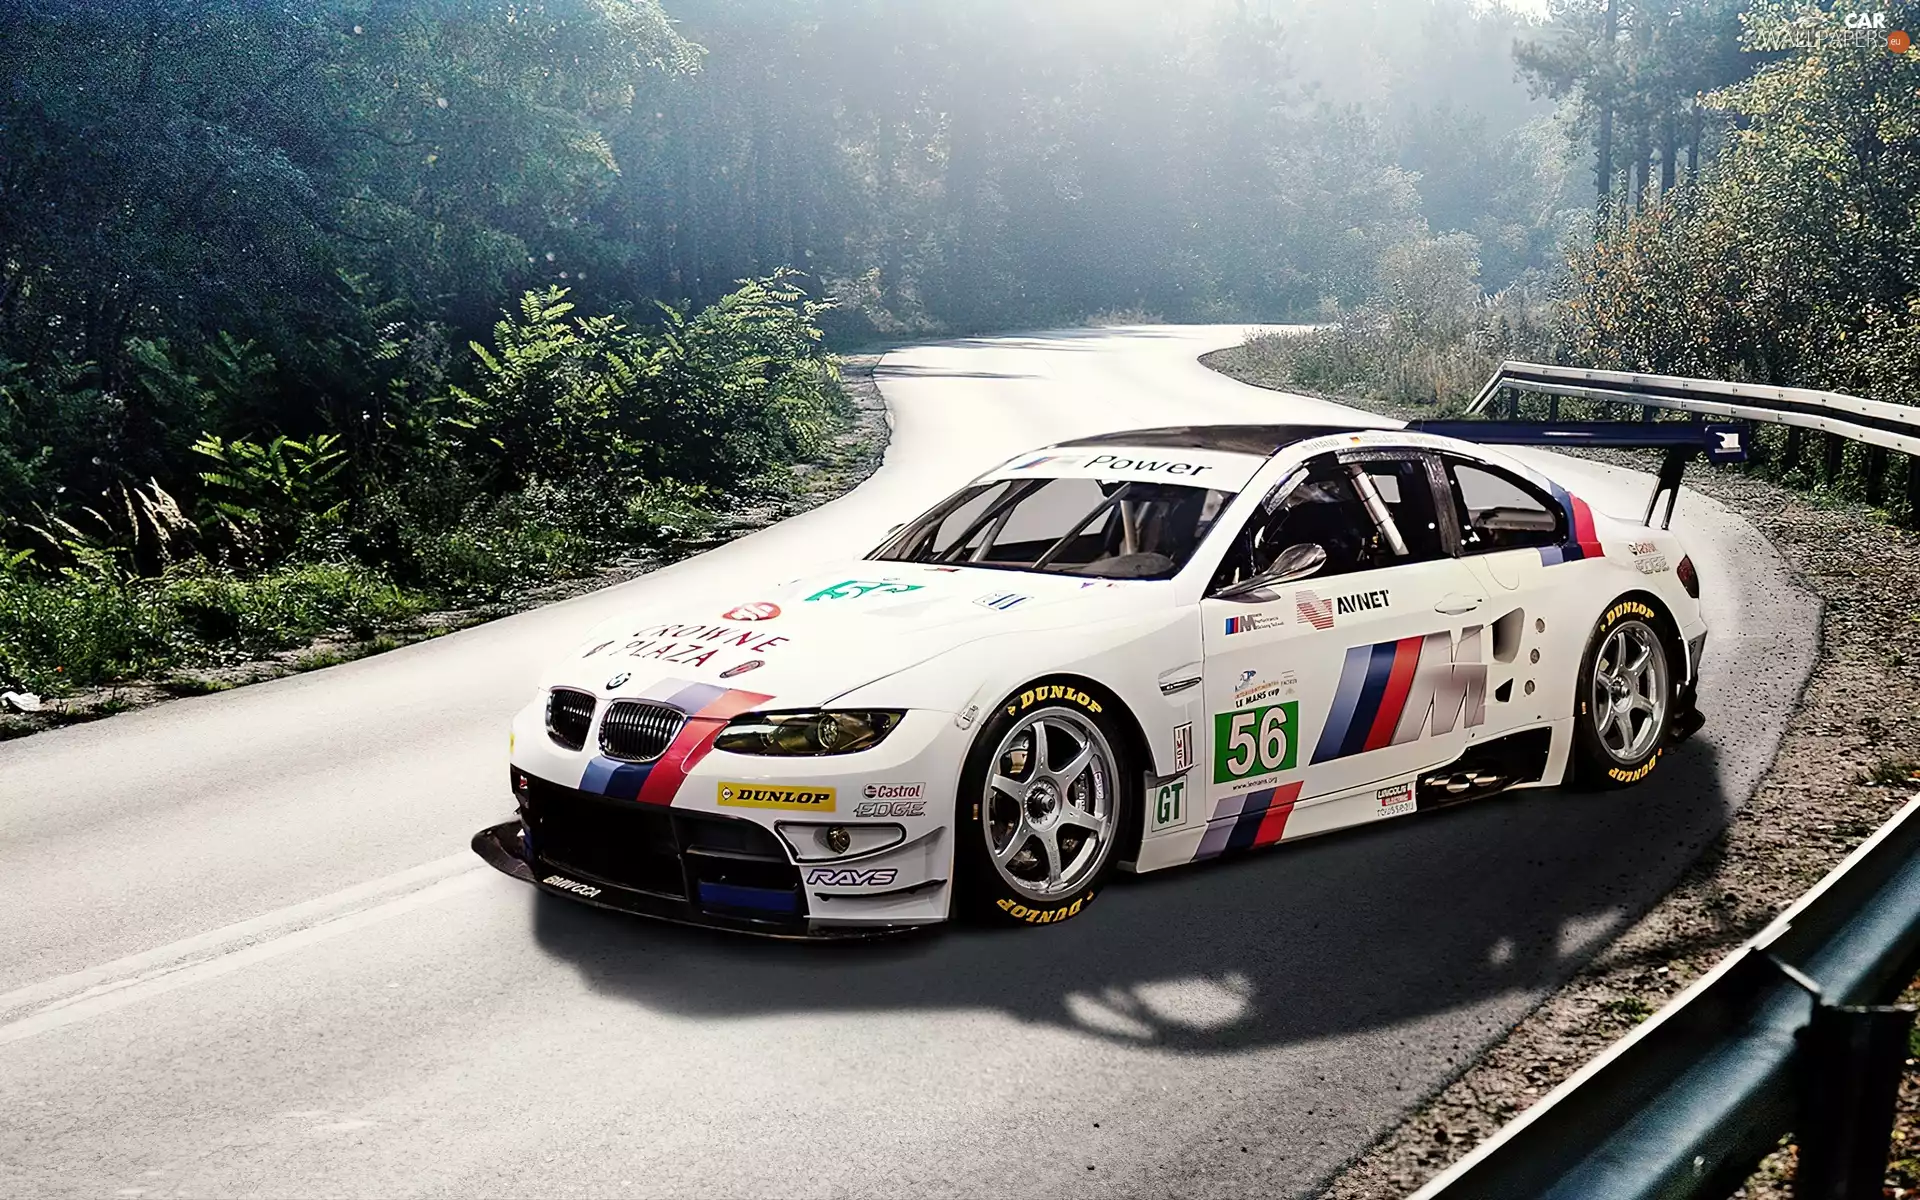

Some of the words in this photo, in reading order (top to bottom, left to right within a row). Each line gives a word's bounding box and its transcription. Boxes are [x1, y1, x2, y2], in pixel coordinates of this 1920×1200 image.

[1084, 455, 1213, 476] Power
[1337, 589, 1391, 615] AVNET
[1606, 601, 1655, 627] DUNLOP
[632, 624, 790, 653] CROWNE
[608, 640, 719, 668] PLAZA
[1021, 685, 1102, 714] DUNLOP
[1227, 705, 1288, 777] 56
[1608, 754, 1656, 783] DUNLOP
[736, 788, 830, 805] DUNLOP
[877, 784, 920, 799] Castrol
[1157, 781, 1185, 824] GT
[853, 801, 928, 818] EDGE
[806, 868, 898, 886] RAYS
[996, 897, 1083, 924] DUNLOP
